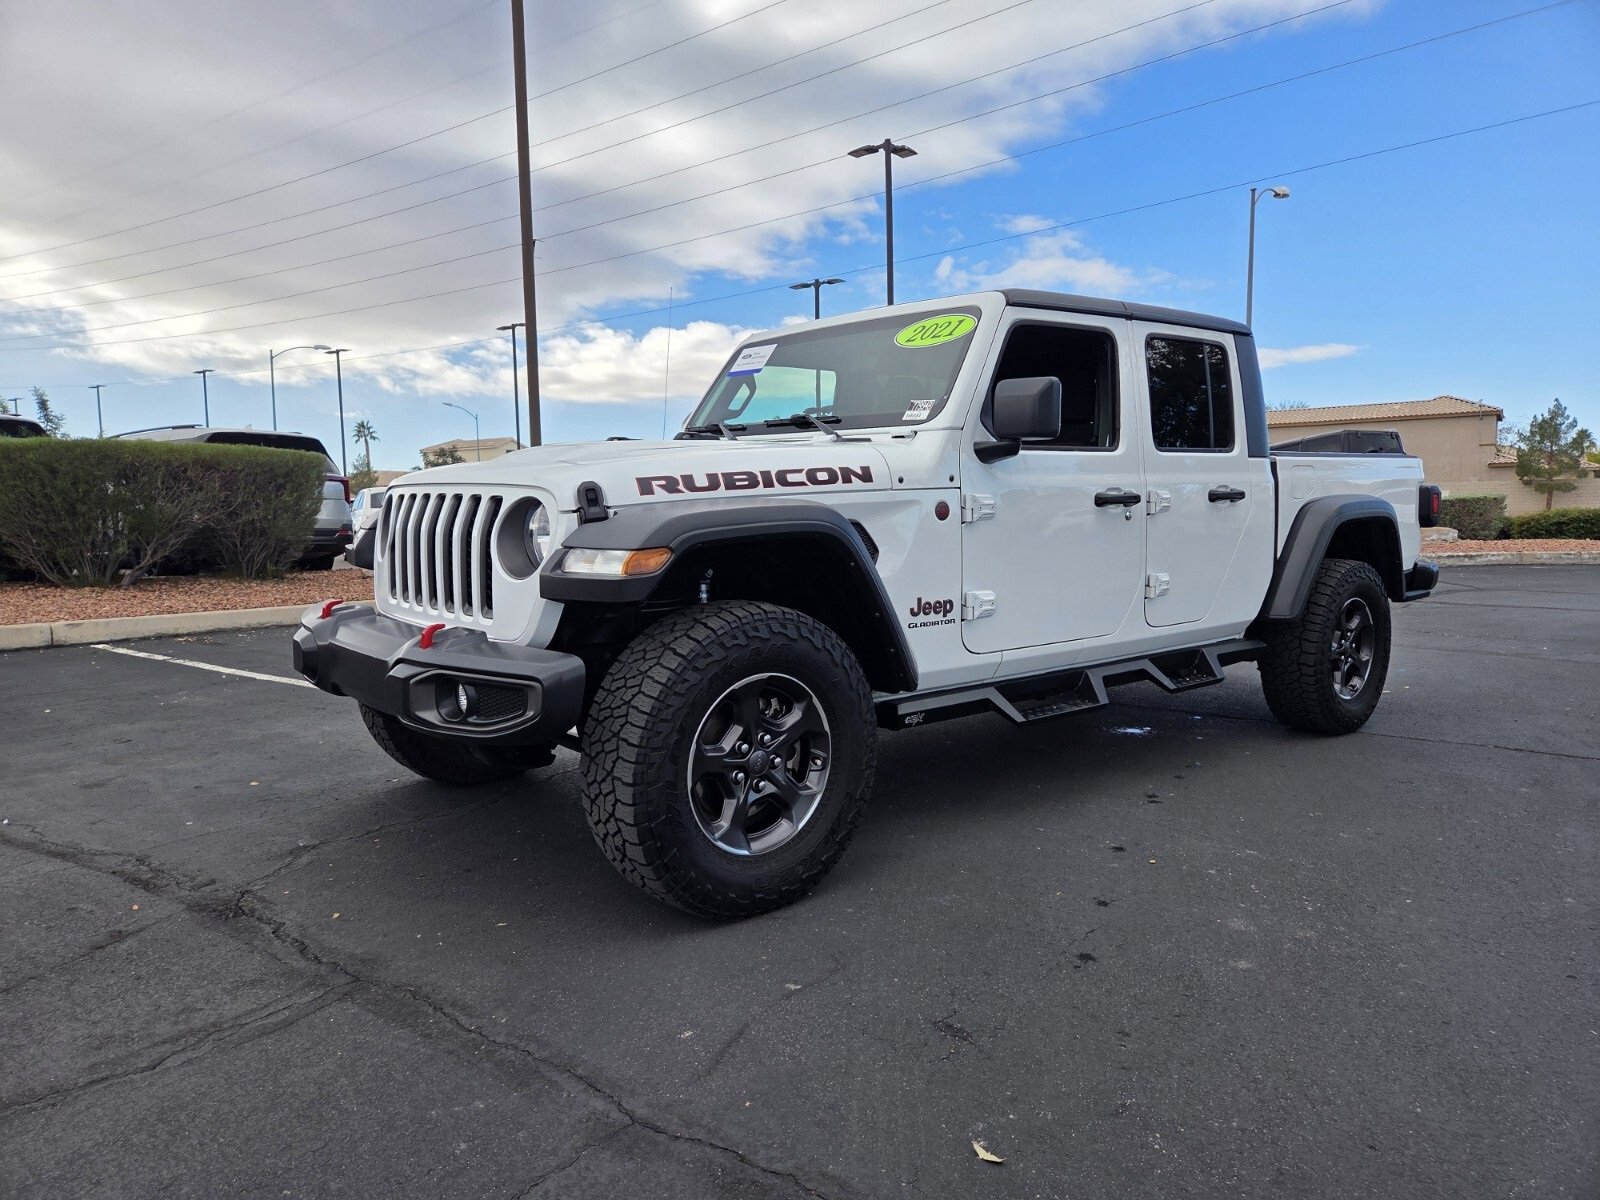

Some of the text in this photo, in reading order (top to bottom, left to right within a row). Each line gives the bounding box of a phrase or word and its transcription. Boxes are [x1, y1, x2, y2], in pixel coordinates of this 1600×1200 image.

[904, 318, 966, 343] 2021
[635, 465, 874, 496] RUBICON
[909, 597, 954, 617] Jeep
[908, 618, 956, 629] GLADIATOR
